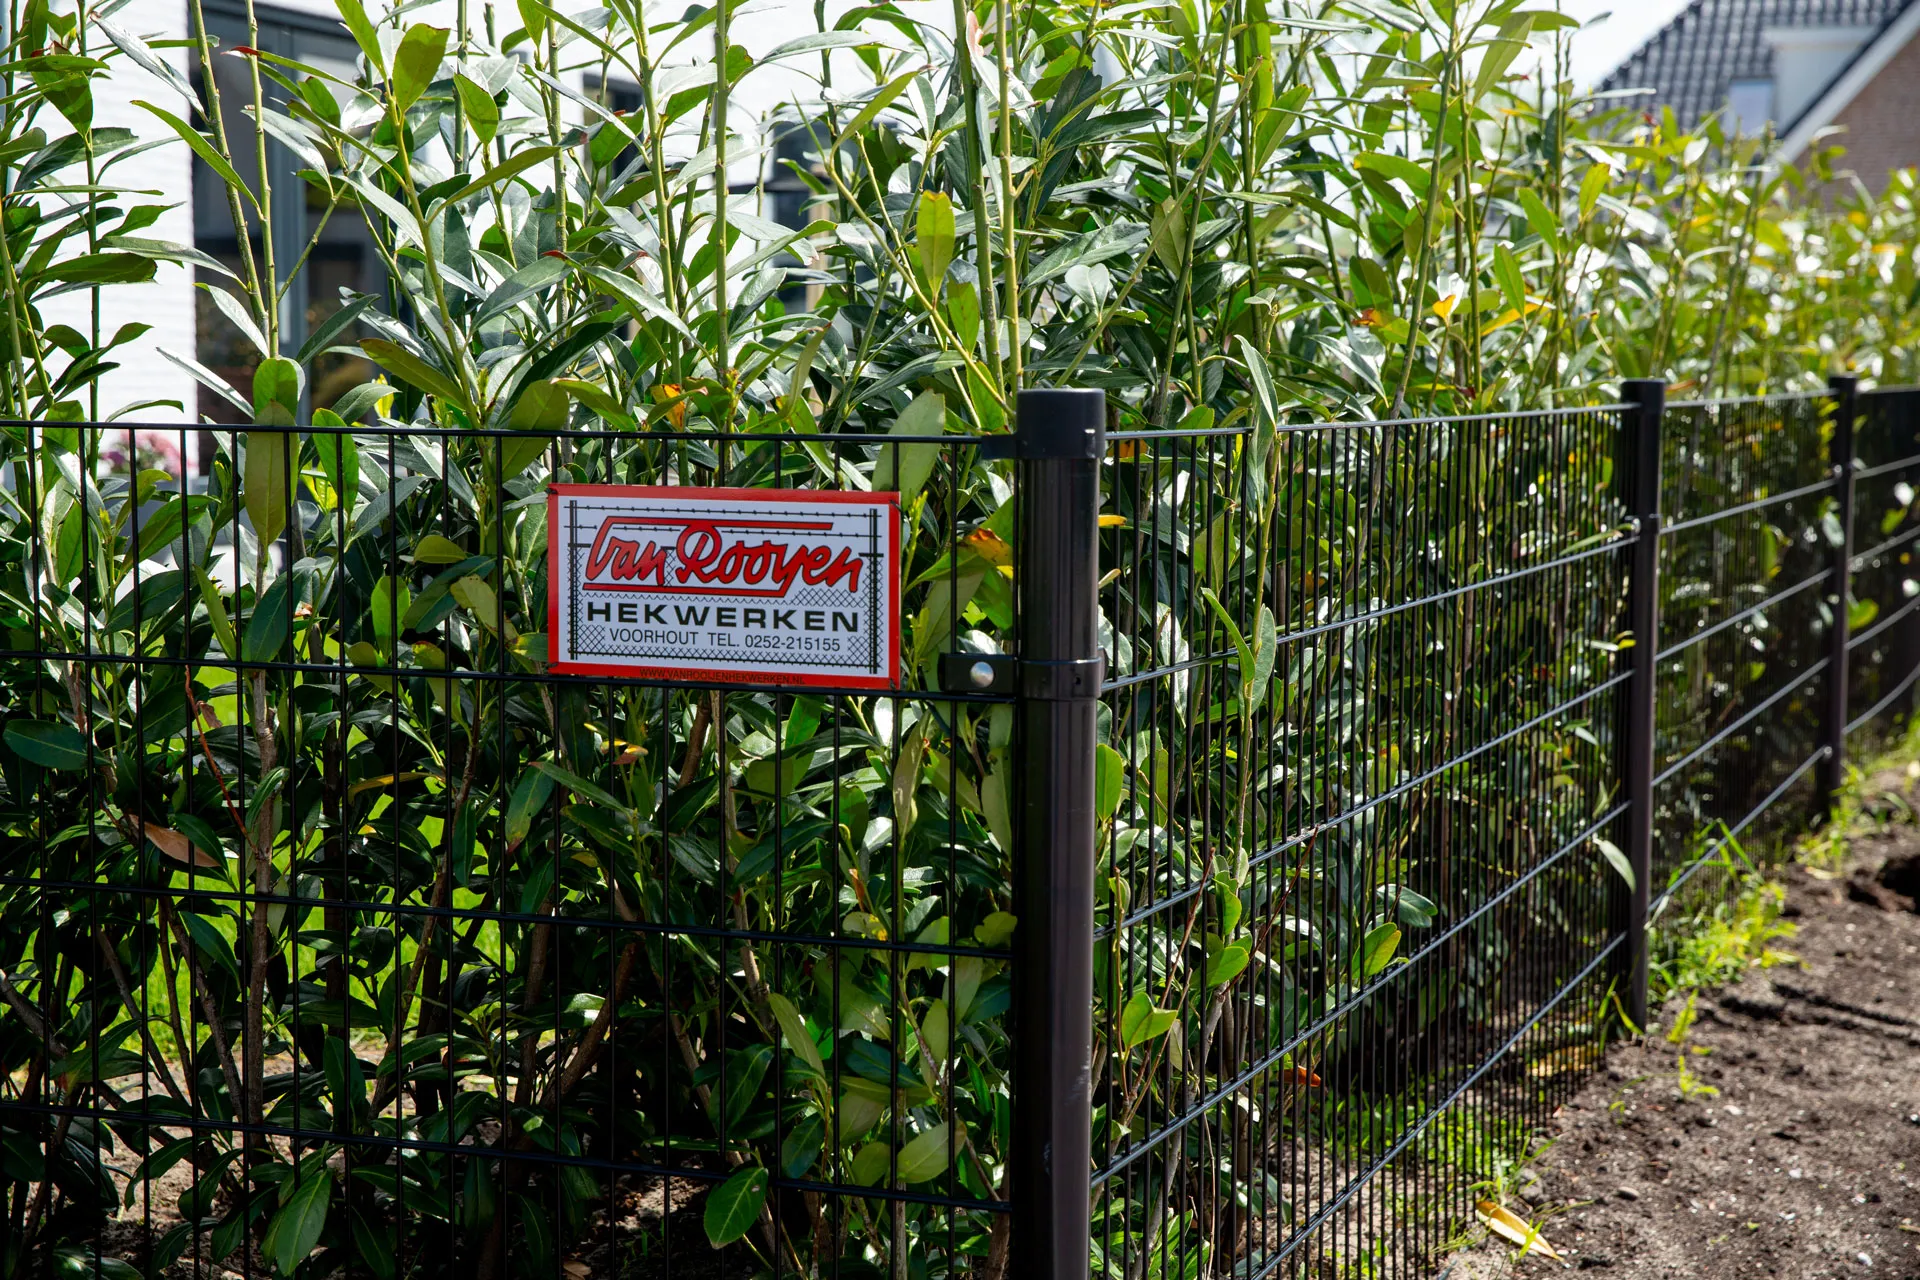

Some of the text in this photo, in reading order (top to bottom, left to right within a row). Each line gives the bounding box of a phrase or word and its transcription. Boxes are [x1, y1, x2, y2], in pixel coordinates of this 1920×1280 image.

[584, 515, 864, 597] Van Rooyen
[587, 601, 858, 633] HEKWERKEN
[609, 628, 841, 652] VOORHOUT TEL. 0252-215155
